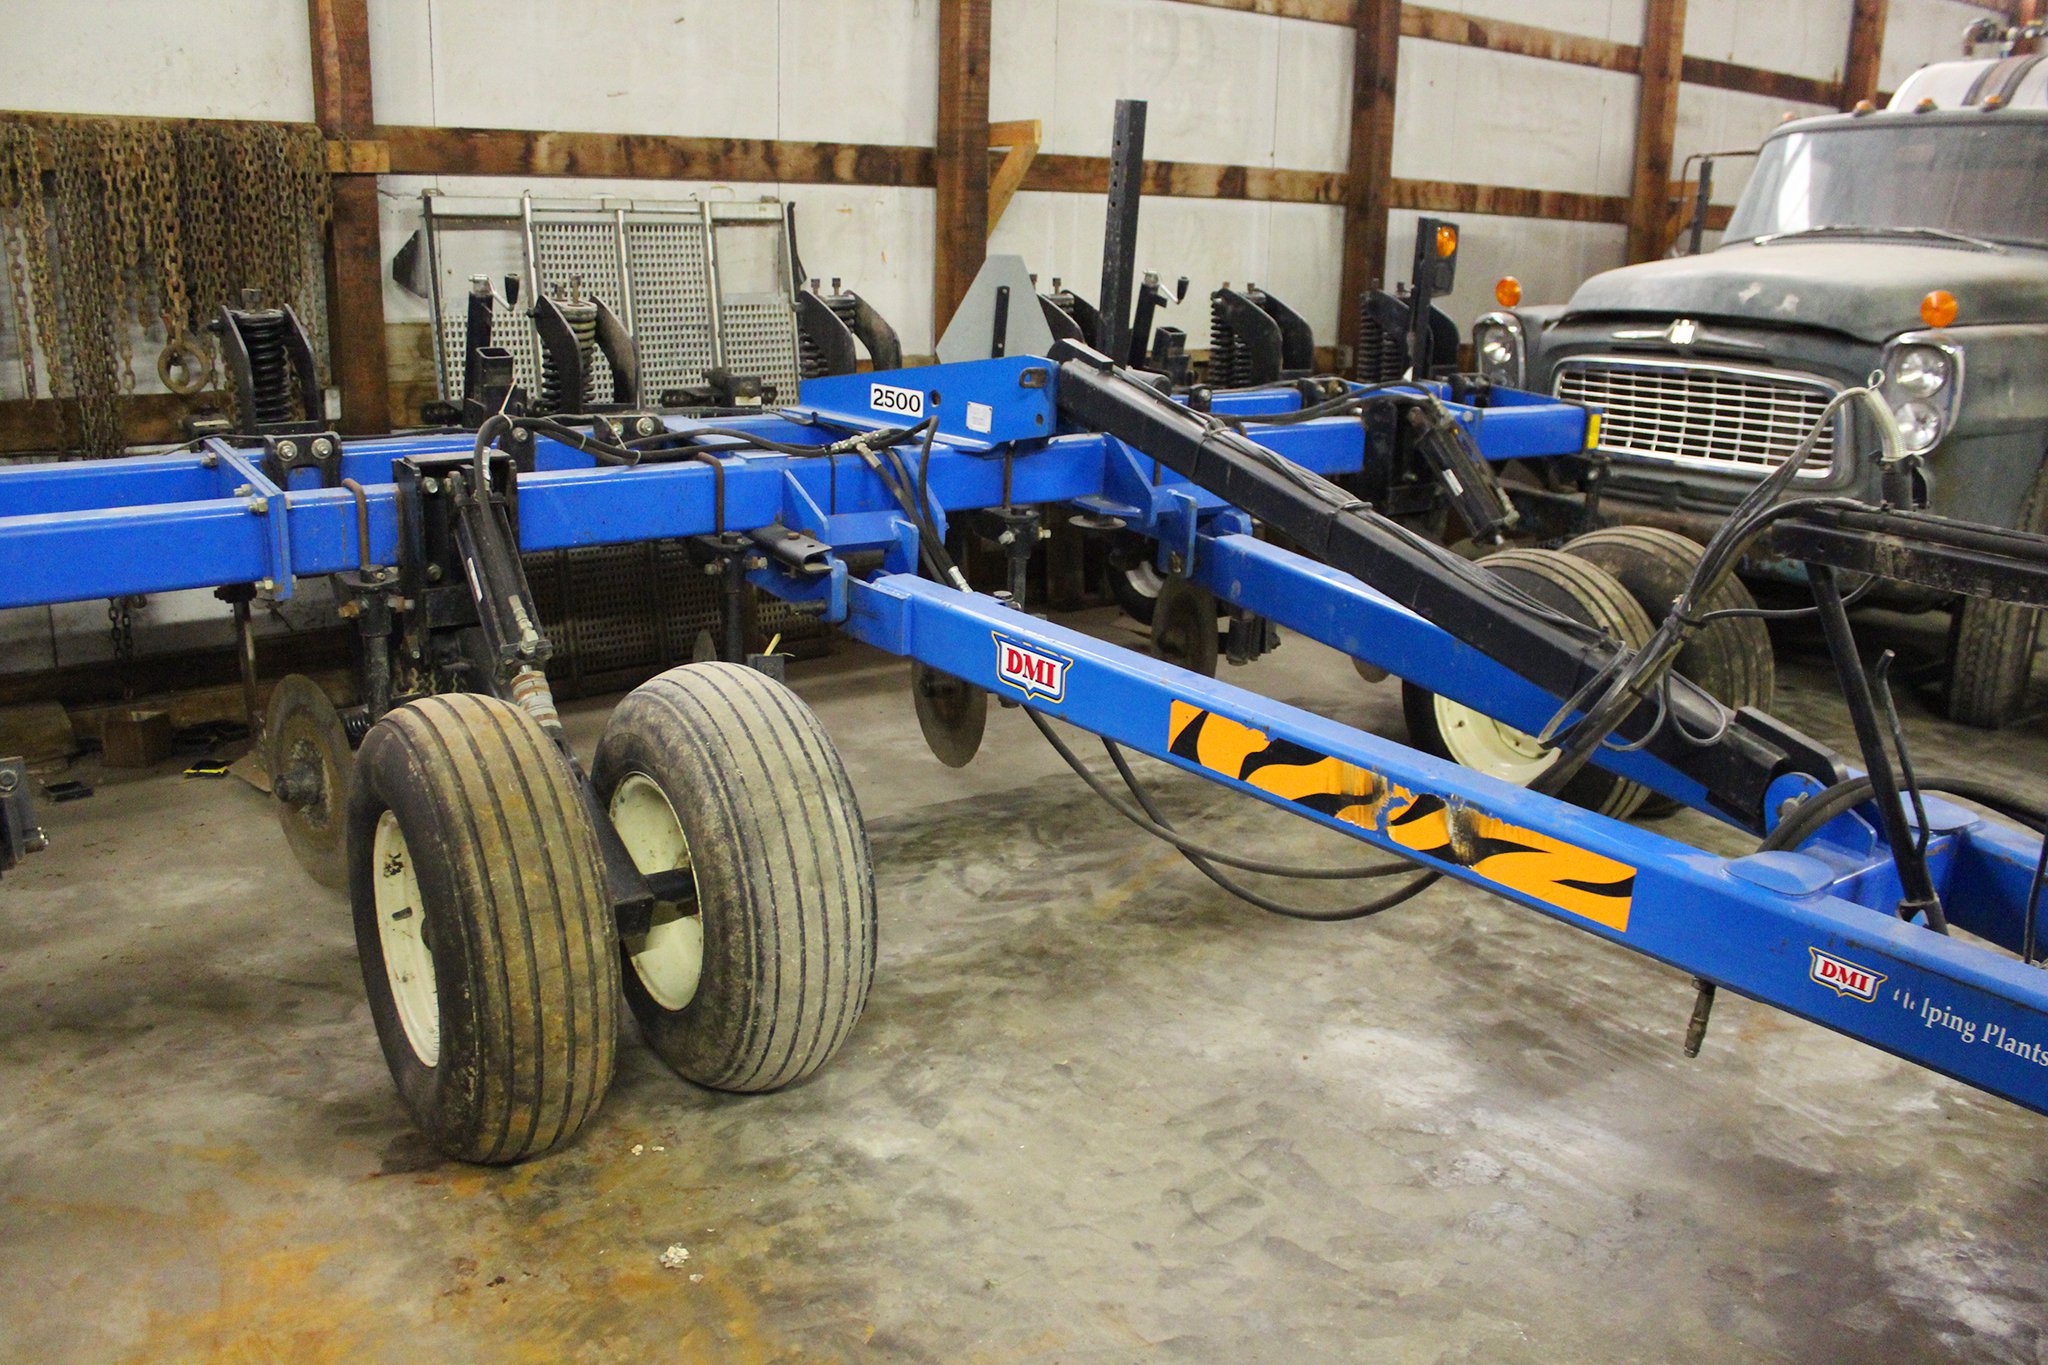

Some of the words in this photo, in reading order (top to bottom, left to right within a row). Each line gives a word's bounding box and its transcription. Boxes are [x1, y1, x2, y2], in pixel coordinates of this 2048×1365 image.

[873, 388, 921, 413] 2500
[1006, 647, 1056, 689] DMI
[1820, 959, 1871, 992] DMI
[1892, 988, 1977, 1044] lping
[1981, 1023, 2048, 1067] Plants
